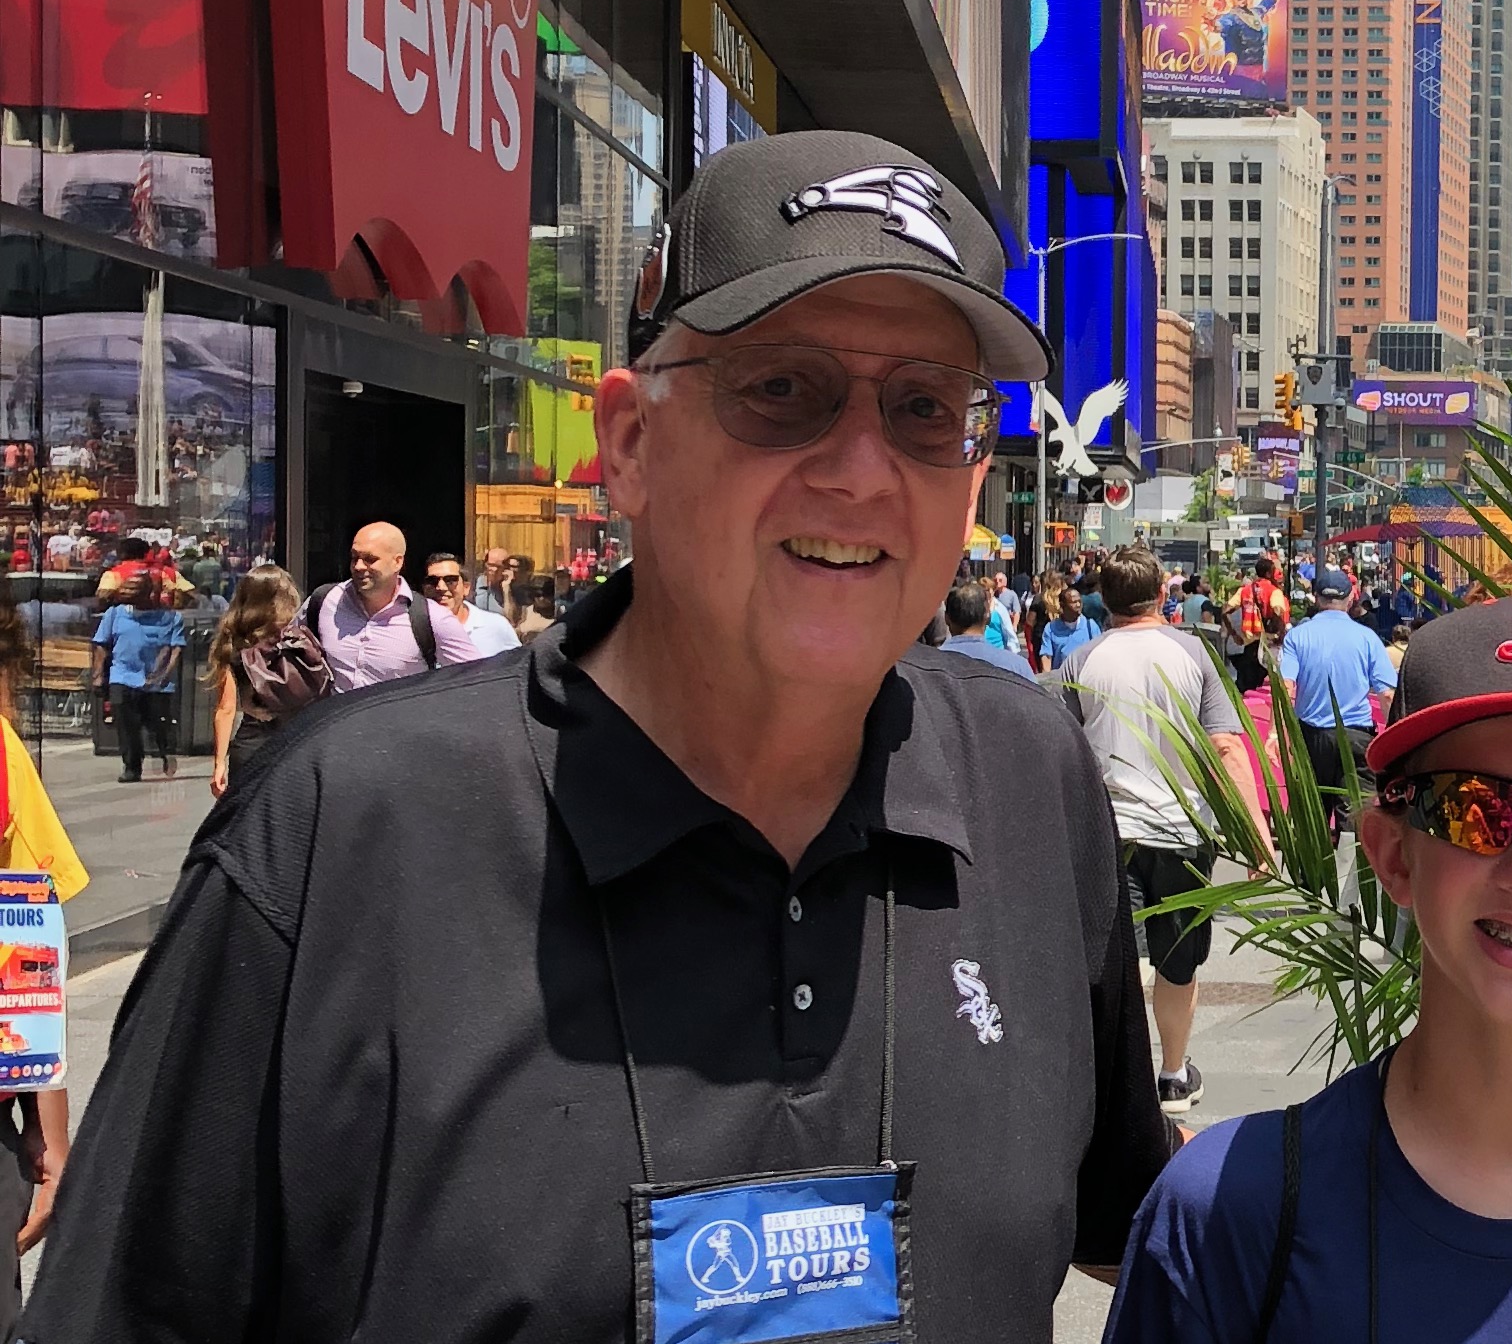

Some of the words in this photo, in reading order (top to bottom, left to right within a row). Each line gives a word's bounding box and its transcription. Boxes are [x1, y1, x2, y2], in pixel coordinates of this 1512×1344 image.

[1190, 74, 1226, 83] MUSICAL
[1382, 392, 1444, 407] SHOUT
[767, 1215, 788, 1230] JAY
[795, 1205, 863, 1226] BUCKLEY'S
[764, 1221, 870, 1257] BASEBALL
[766, 1247, 871, 1285] TOURS
[694, 1287, 789, 1311] jaybuckley.com
